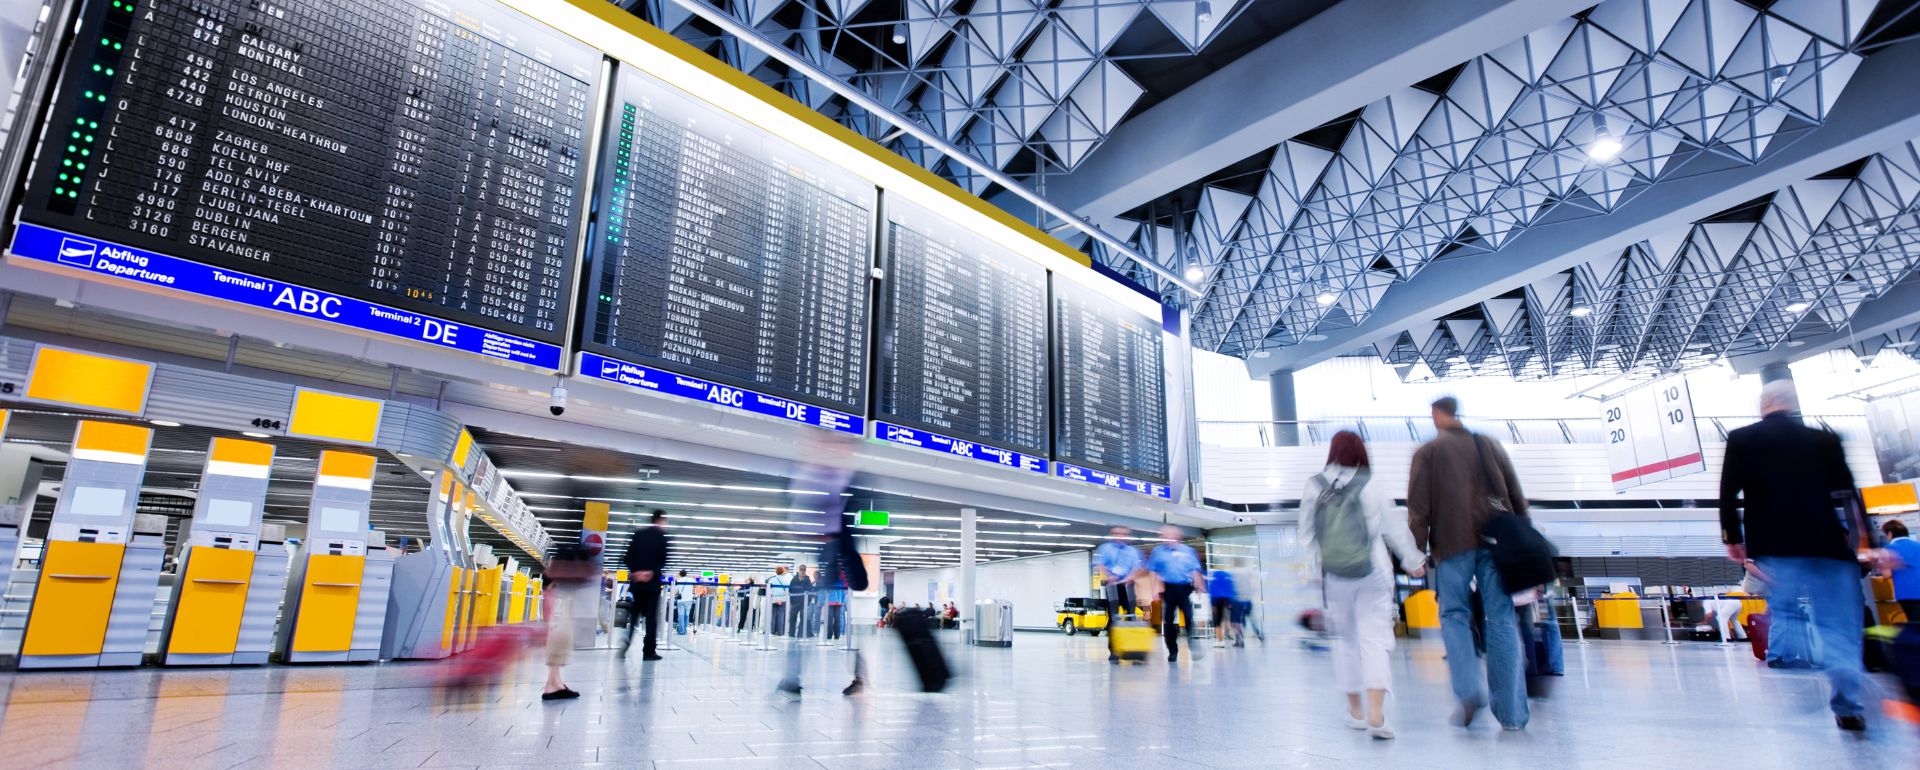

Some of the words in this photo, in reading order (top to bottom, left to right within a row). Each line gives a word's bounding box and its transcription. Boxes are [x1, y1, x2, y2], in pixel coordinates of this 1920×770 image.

[193, 29, 220, 45] 875
[238, 46, 304, 77] MONTREAL
[196, 17, 223, 33] 494
[241, 34, 299, 63] CALGARY
[179, 78, 206, 94] 440
[225, 93, 286, 121] HOUSTON
[183, 66, 210, 82] 442
[228, 82, 288, 109] DETROIT
[186, 53, 213, 69] 456
[232, 70, 258, 85] LOS
[266, 82, 323, 109] ANGELES
[166, 88, 203, 106] 4726
[222, 106, 347, 154] LONDON-HEATHROW
[169, 116, 196, 131] 417
[215, 131, 268, 154] ZAGREB
[155, 126, 192, 144] 6808
[212, 143, 257, 164] KOELN
[266, 160, 290, 173] HBF
[161, 141, 190, 157] 686
[210, 156, 234, 170] TEL
[245, 166, 279, 184] AVIV
[152, 182, 179, 196] 117
[199, 195, 279, 224] LJUBLJANA
[156, 169, 182, 183] 176
[202, 181, 306, 218] BERLIN-TEGEL
[158, 155, 186, 170] 590
[205, 168, 250, 188] ADDIS
[259, 184, 372, 223] ABEBA-KHARTOUM
[133, 206, 172, 223] 3126
[192, 221, 247, 242] BERGEN
[136, 192, 175, 210] 4980
[195, 208, 250, 230] DUBLIN
[100, 247, 148, 267] Abflug
[129, 220, 168, 237] 3160
[189, 234, 270, 261] STAVANGER
[96, 259, 175, 284] Departures
[213, 271, 265, 292] Terminal
[268, 283, 274, 293] 1
[273, 287, 342, 318] ABC
[370, 307, 413, 324] Terminal
[414, 317, 421, 326] 2
[423, 320, 459, 345] DE
[620, 365, 645, 378] Abflug
[620, 374, 658, 388] Departures
[676, 377, 703, 390] Terminal
[707, 386, 743, 407] ABC
[757, 396, 782, 407] Terminal
[787, 402, 806, 421] DE
[1663, 386, 1678, 402] 10
[252, 418, 280, 429] 464
[1607, 407, 1621, 422] 20
[1668, 409, 1683, 424] 10
[951, 441, 973, 456] ABC
[999, 451, 1012, 465] DE
[1610, 429, 1625, 444] 20
[1105, 475, 1119, 487] ABC
[1137, 482, 1146, 492] DE
